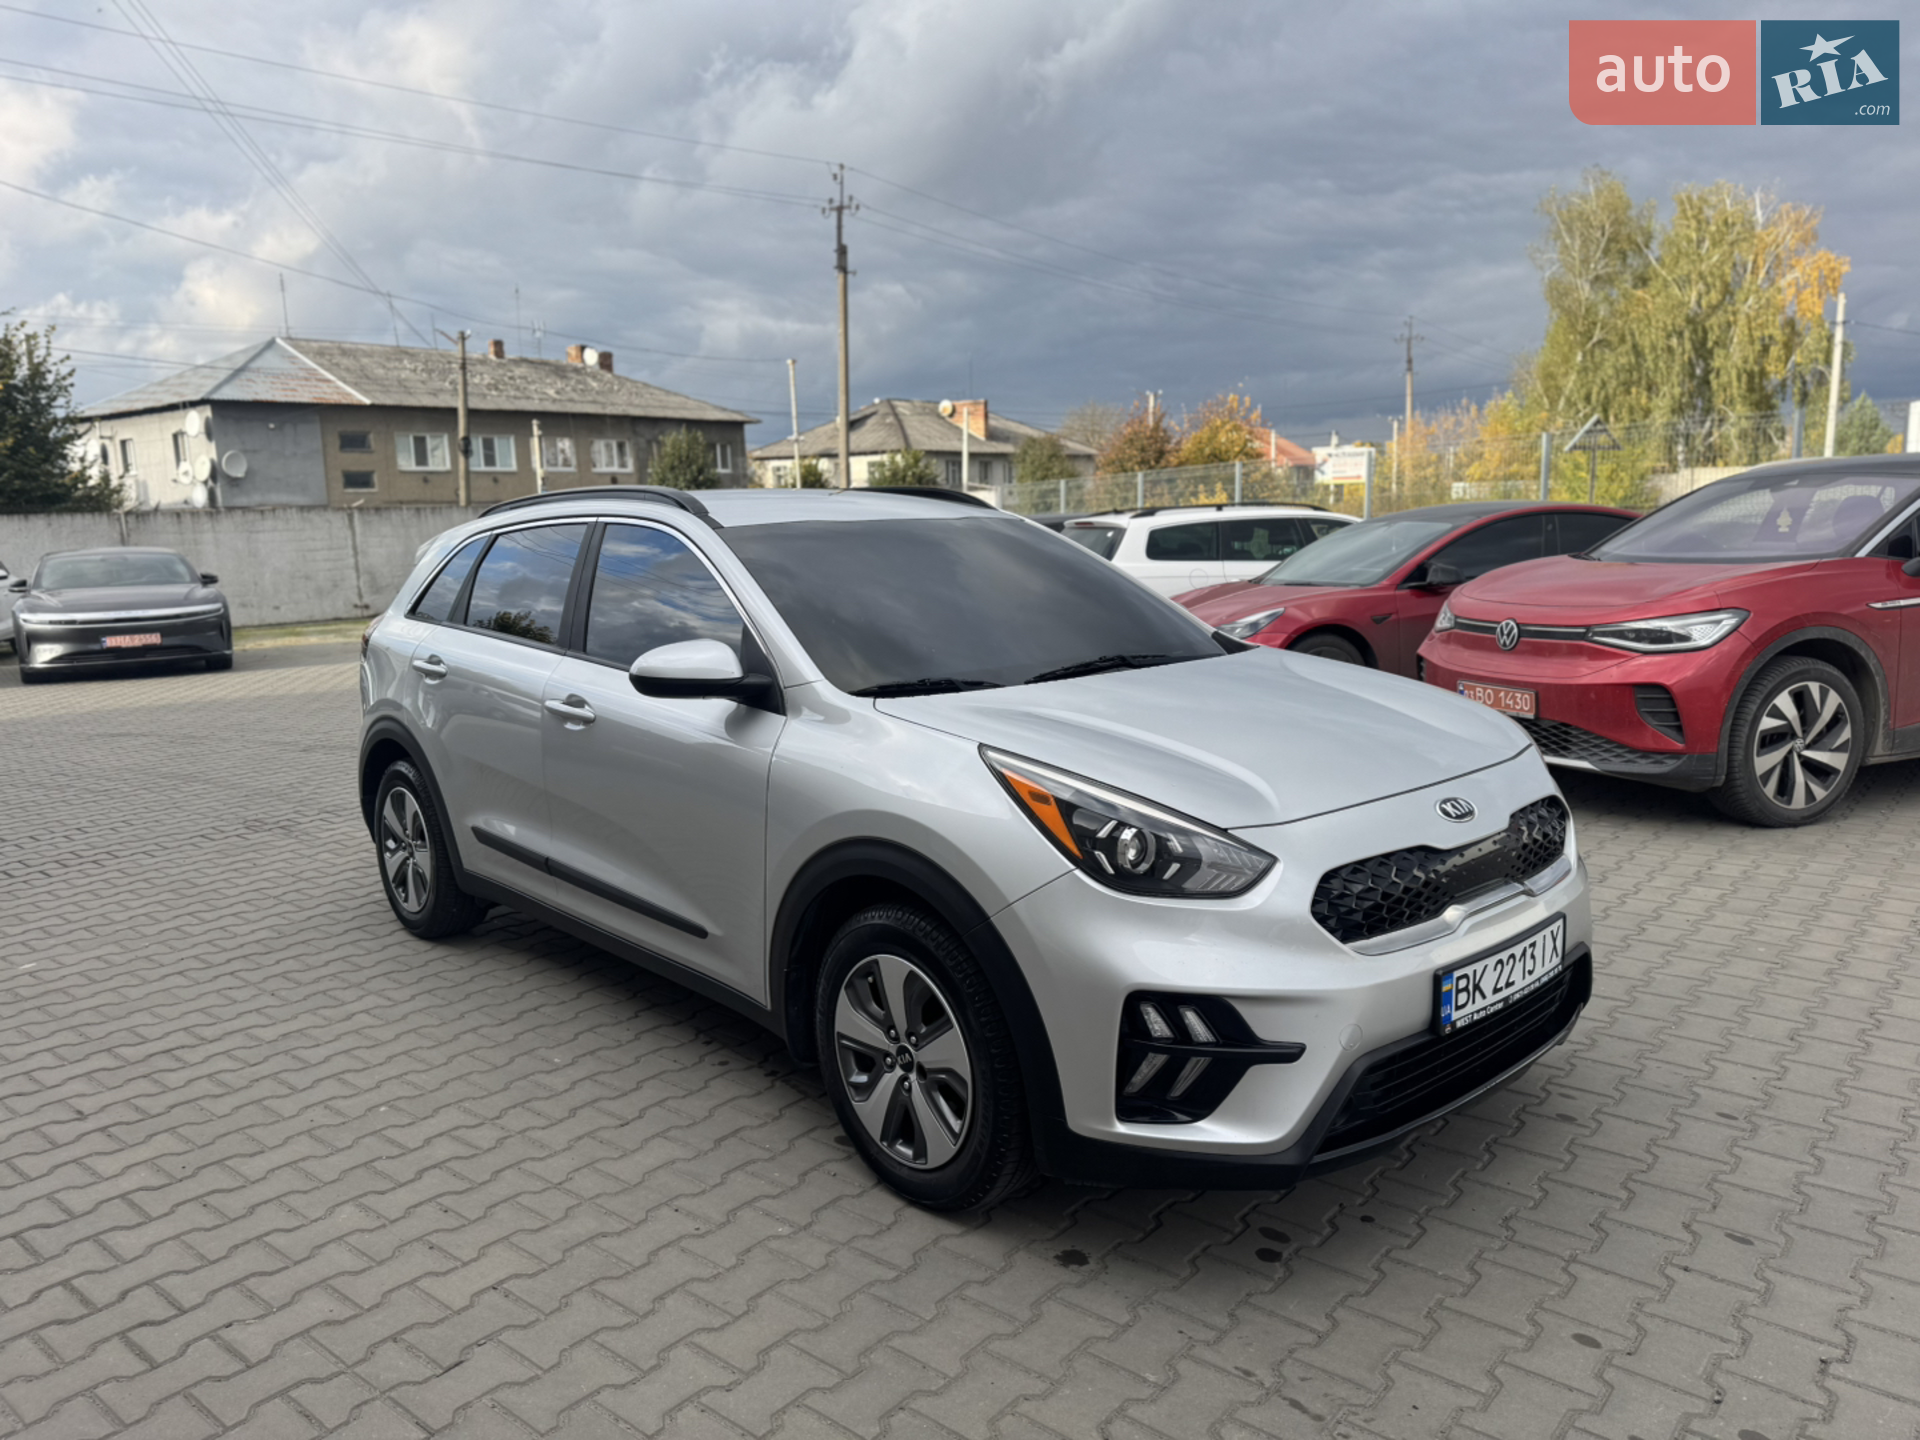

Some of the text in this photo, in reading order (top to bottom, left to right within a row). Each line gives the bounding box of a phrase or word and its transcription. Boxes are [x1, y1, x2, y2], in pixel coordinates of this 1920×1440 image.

[1498, 691, 1531, 711] 1430
[1441, 799, 1473, 818] KIA
[1454, 964, 1489, 1012] BK
[1492, 940, 1537, 996] 2213
[1541, 925, 1561, 968] IX
[897, 1053, 912, 1065] KIA
